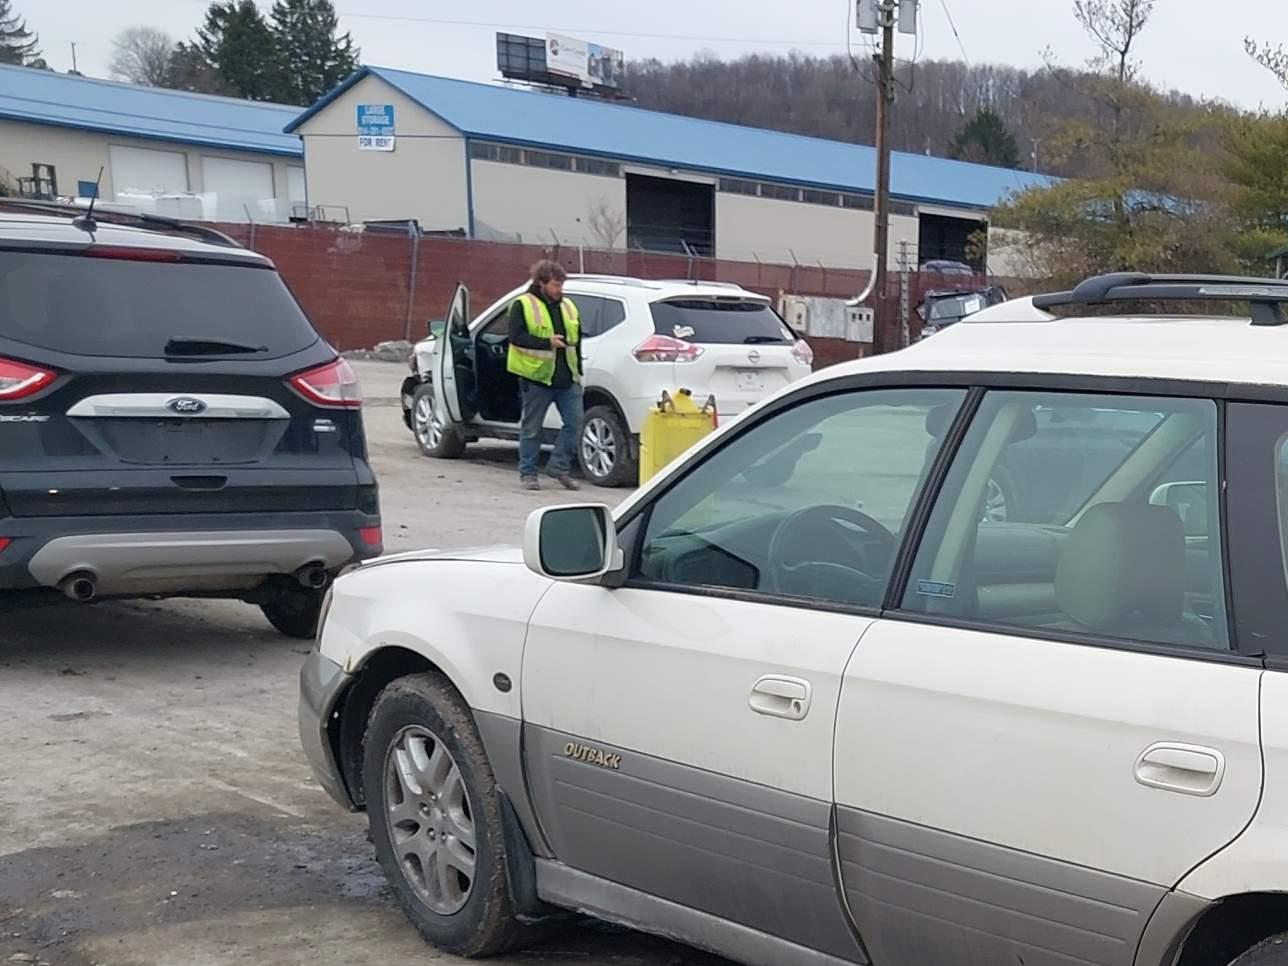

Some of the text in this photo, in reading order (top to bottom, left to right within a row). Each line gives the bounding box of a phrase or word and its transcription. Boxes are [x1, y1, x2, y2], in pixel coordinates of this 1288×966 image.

[359, 137, 392, 147] FOR RENT
[565, 742, 621, 769] OUTBACK
